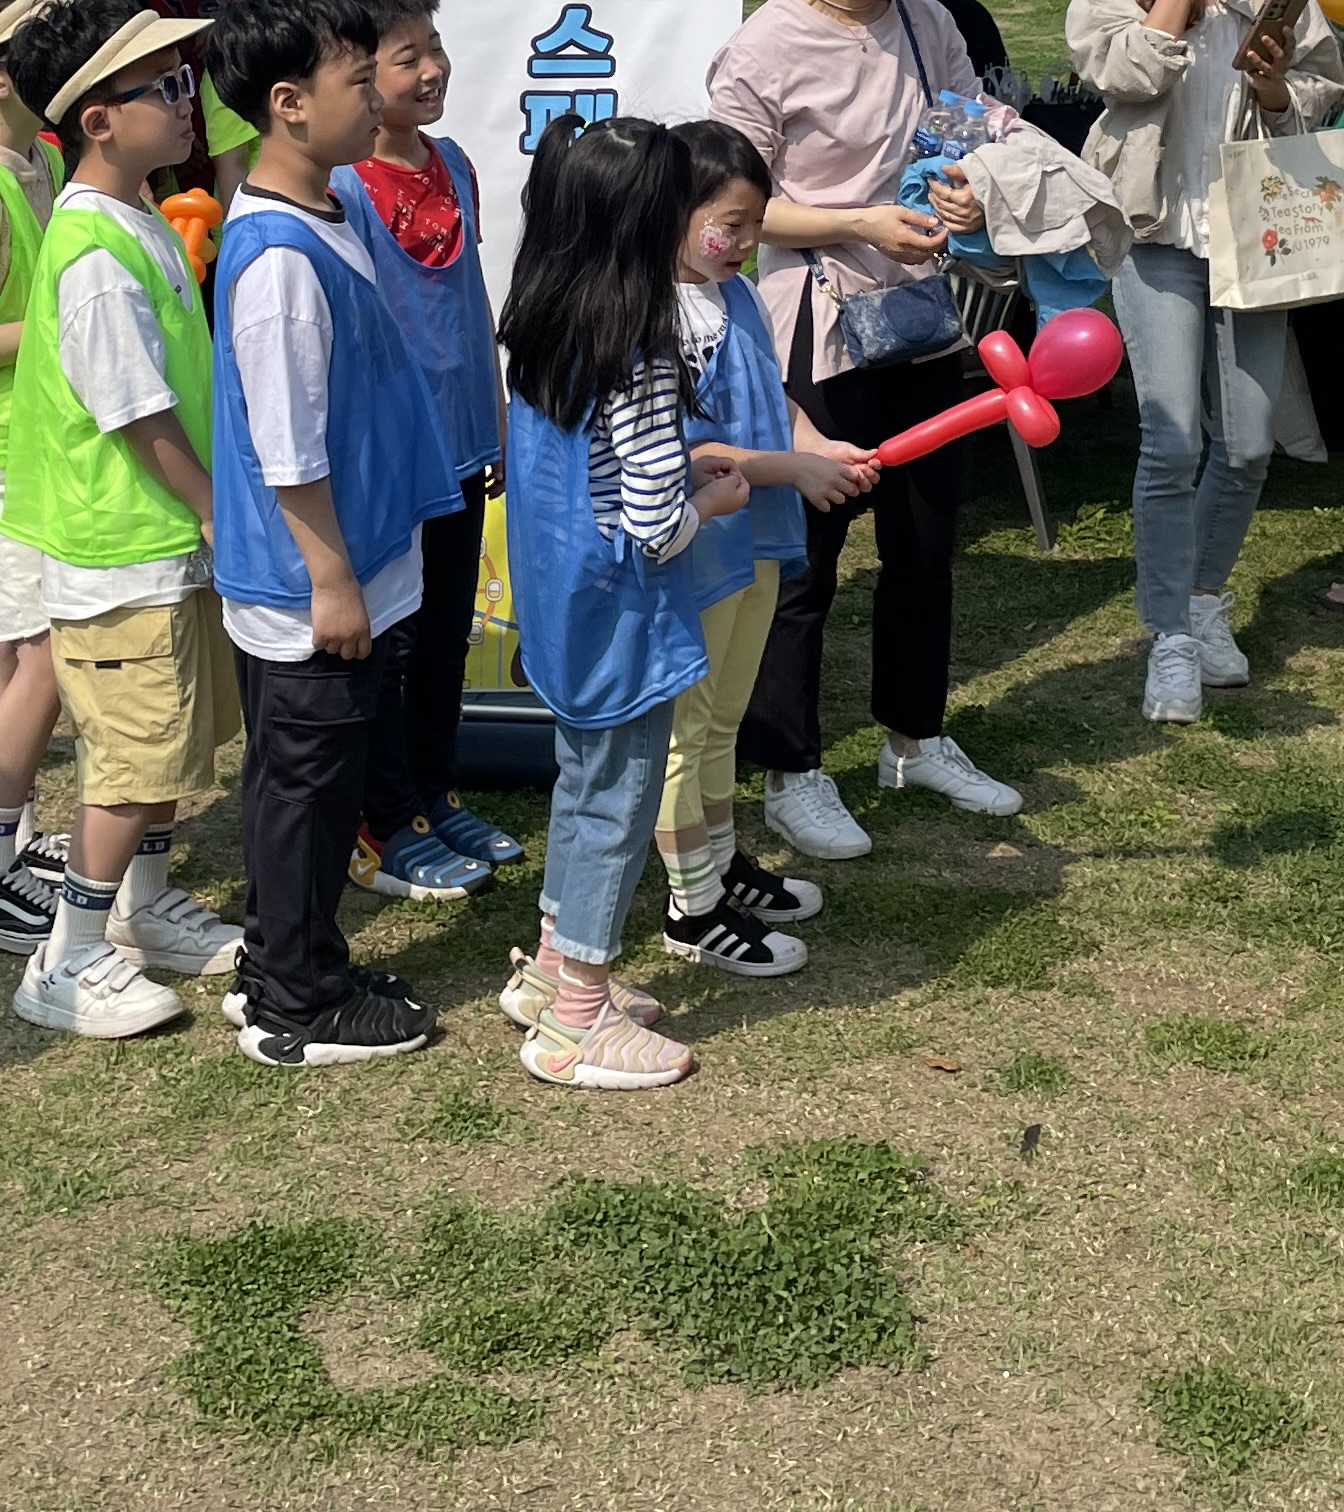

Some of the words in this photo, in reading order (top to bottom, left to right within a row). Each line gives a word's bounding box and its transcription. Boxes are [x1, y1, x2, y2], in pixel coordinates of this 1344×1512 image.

[1270, 206, 1291, 219] Tea
[1272, 223, 1292, 236] Tea
[1293, 223, 1324, 236] From
[1303, 235, 1330, 250] 1979
